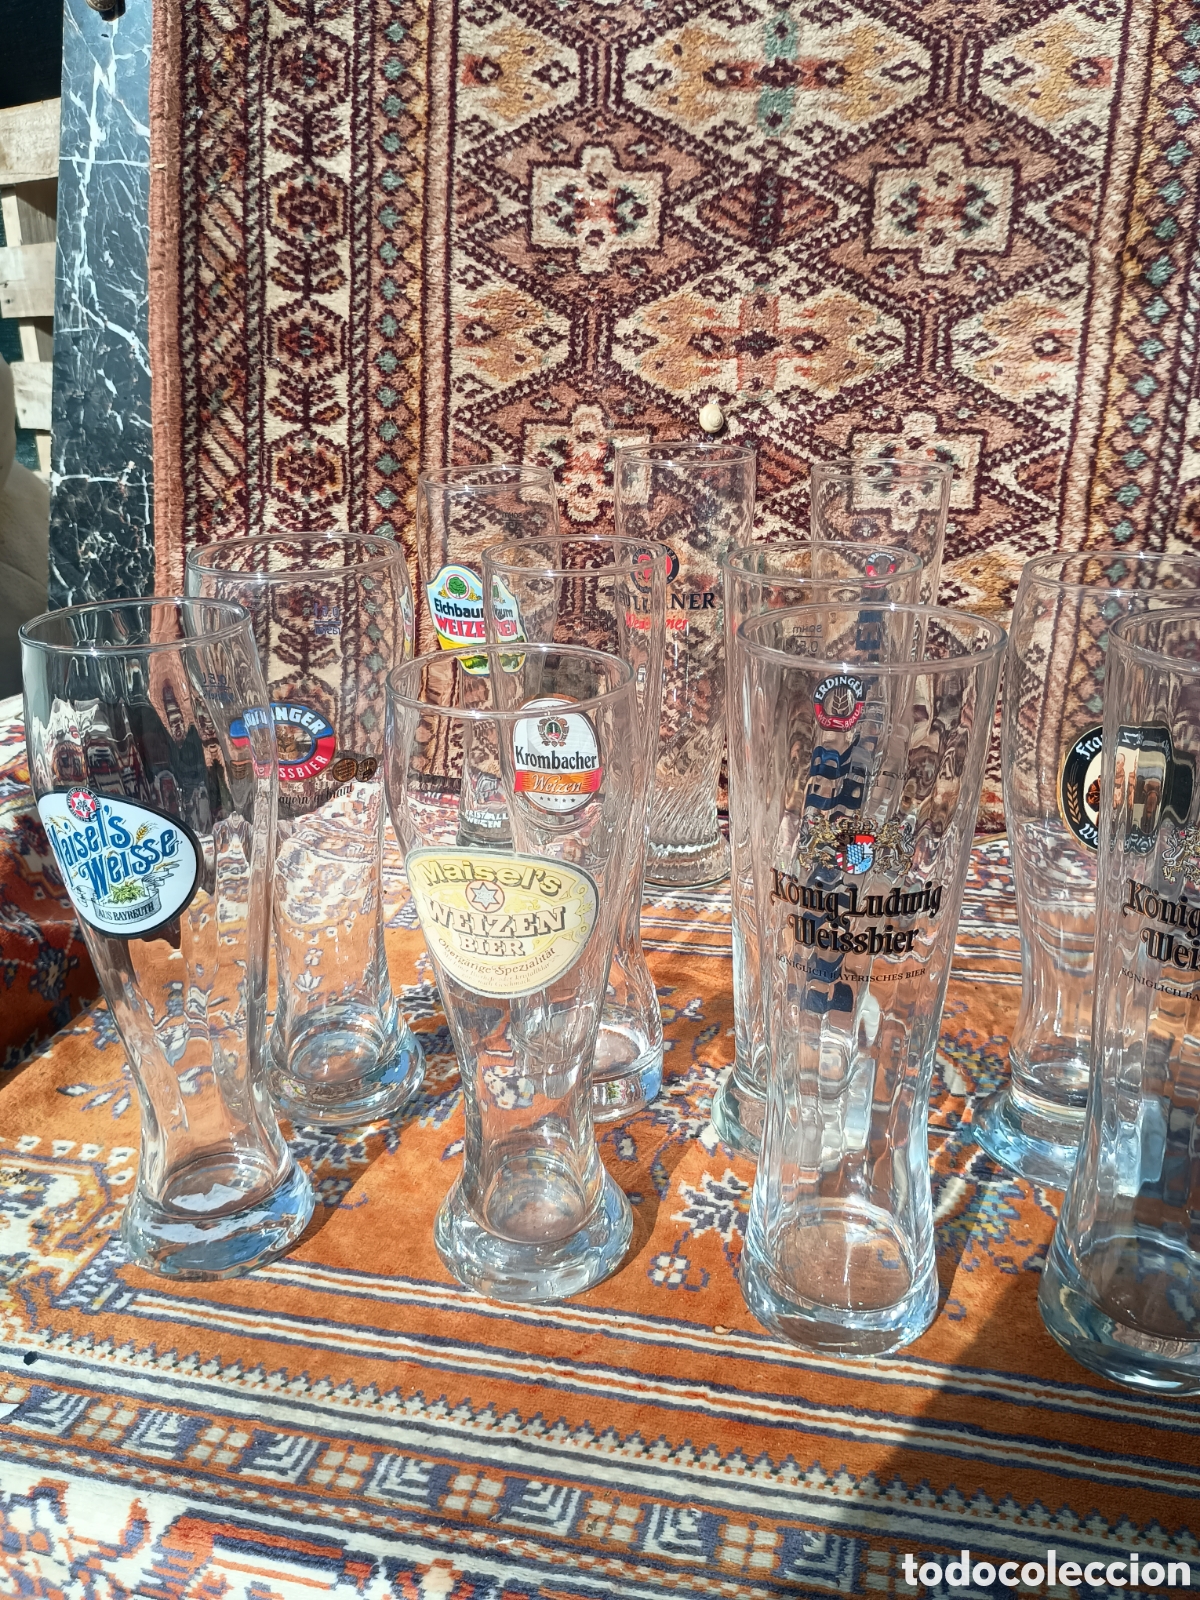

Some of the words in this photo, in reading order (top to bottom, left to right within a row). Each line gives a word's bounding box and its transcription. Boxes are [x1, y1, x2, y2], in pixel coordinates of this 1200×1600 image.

[815, 676, 863, 700] ERDINGER
[515, 746, 597, 770] Krombacher
[531, 774, 583, 792] Weizen
[78, 829, 177, 900] Weisse
[416, 860, 563, 897] Maisel's
[770, 868, 839, 922] König
[840, 881, 943, 928] Ludwig
[98, 908, 113, 920] AUS
[113, 902, 155, 921] BAYREUTH
[423, 897, 567, 938] WEIZEN
[459, 932, 526, 957] BIER
[787, 914, 920, 956] Weissbier
[829, 971, 904, 982] BAYERISCHES
[905, 967, 926, 980] BIER
